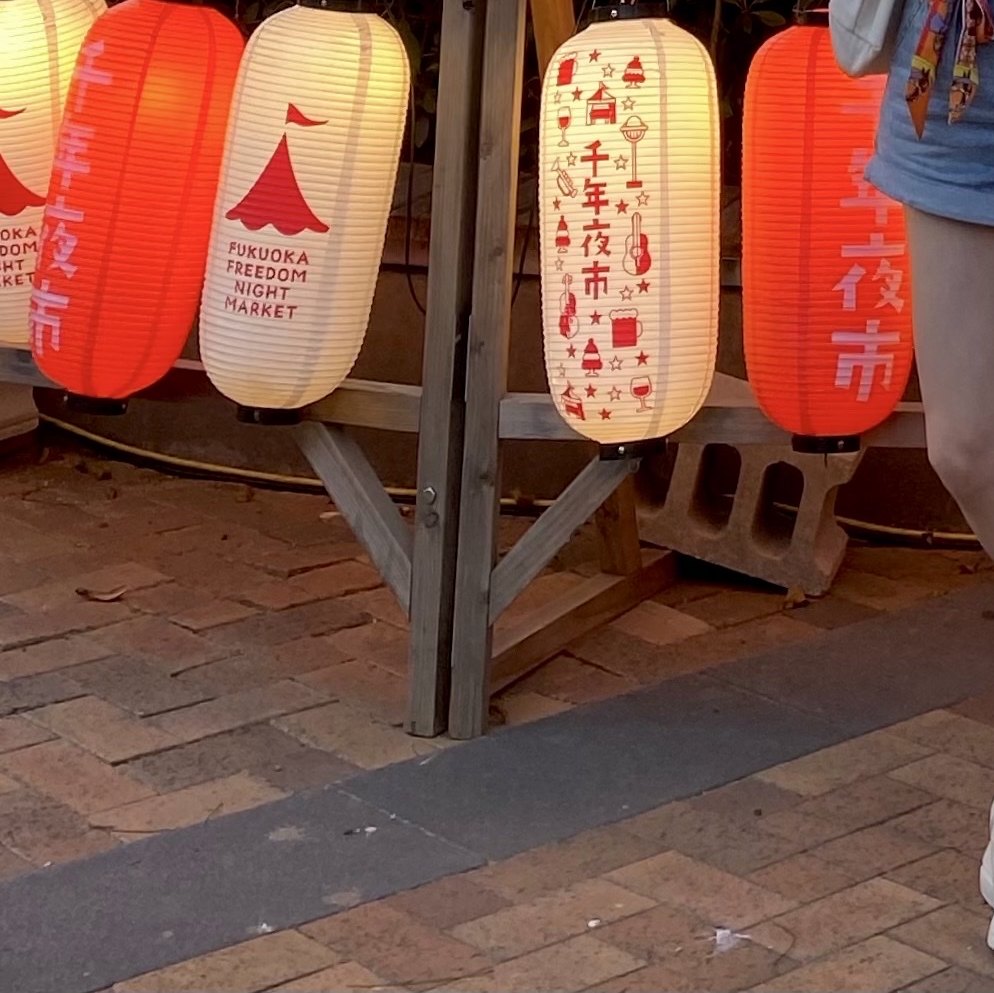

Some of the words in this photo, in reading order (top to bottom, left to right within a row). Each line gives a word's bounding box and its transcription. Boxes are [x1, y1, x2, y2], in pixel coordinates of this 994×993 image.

[580, 139, 611, 301] 千年夜市
[228, 241, 310, 265] FUKUOKA
[226, 259, 307, 283] FREEDOM
[234, 280, 291, 300] NIGHT
[224, 295, 298, 319] MARKET
